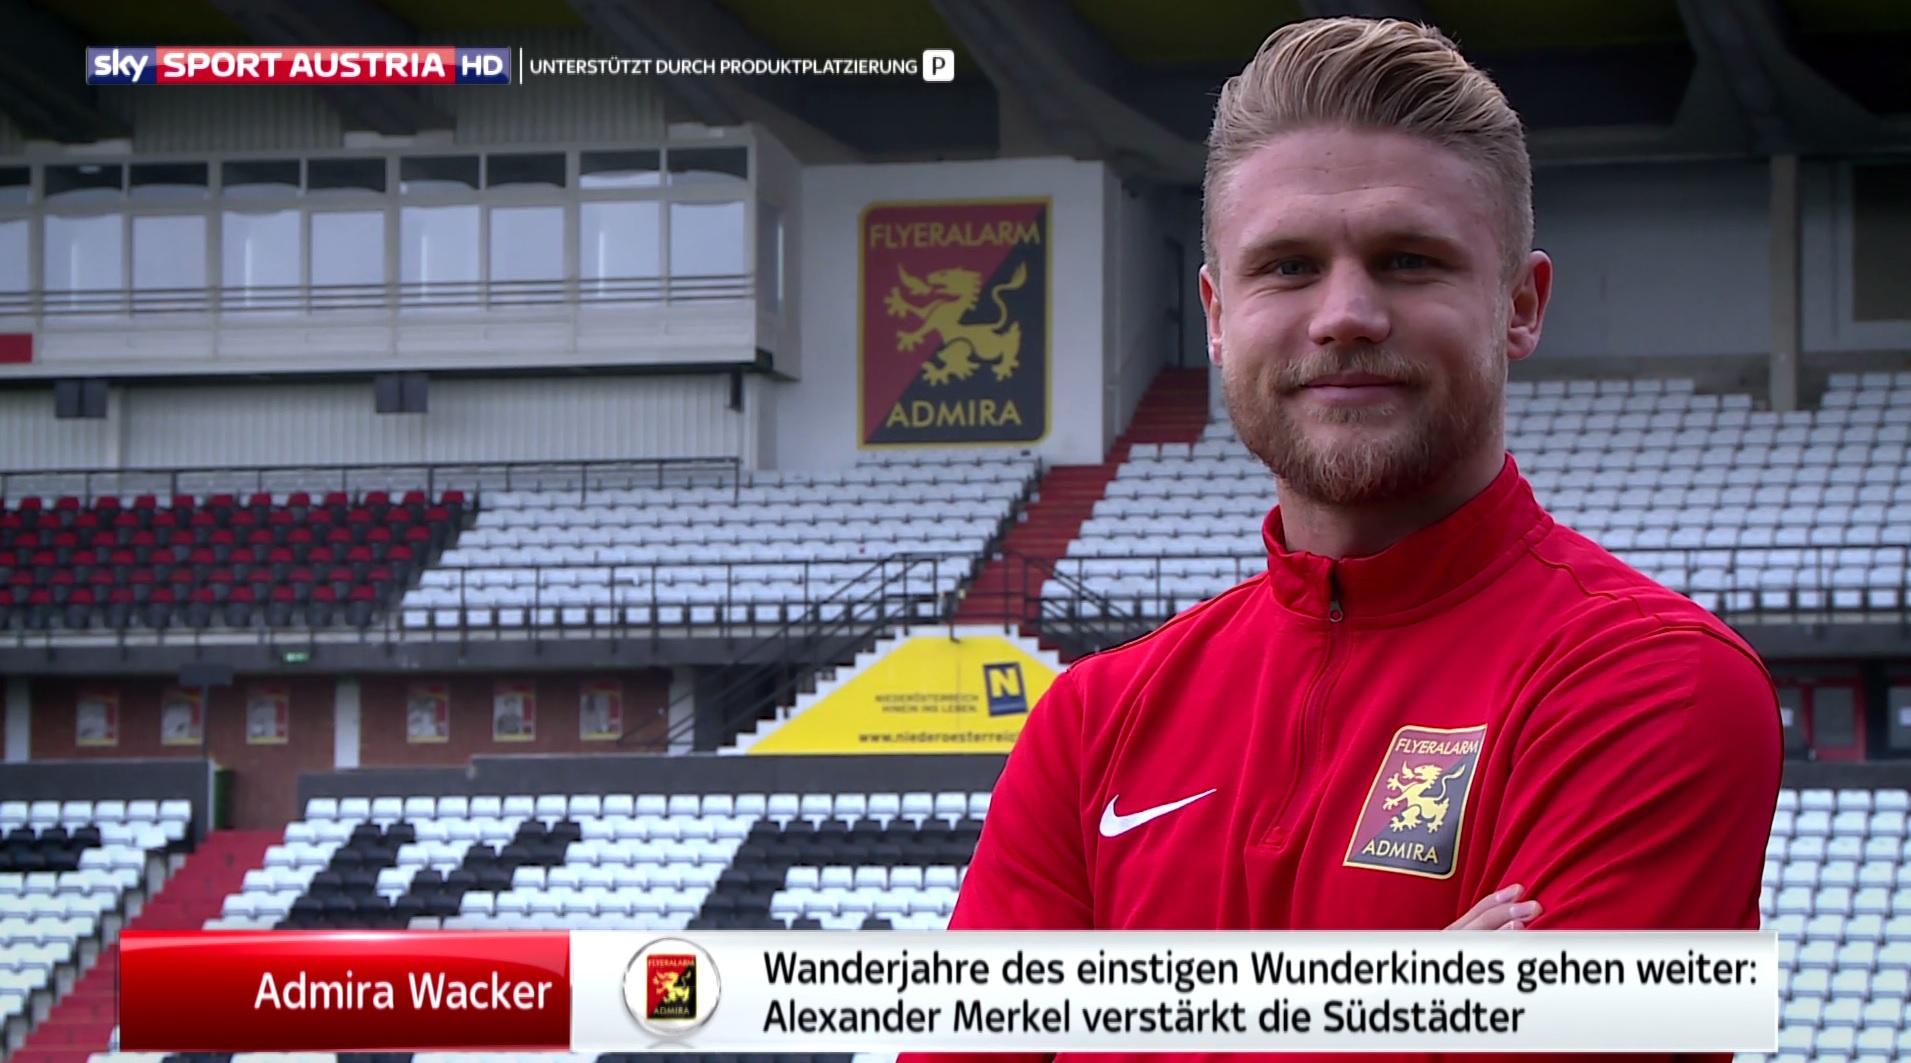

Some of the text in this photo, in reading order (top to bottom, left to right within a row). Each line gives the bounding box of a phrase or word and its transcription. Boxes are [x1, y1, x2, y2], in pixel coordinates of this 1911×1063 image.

[869, 221, 1041, 248] FLYERALARM
[886, 400, 1022, 428] ADMIRA
[1395, 738, 1479, 756] FLYERALARM
[1361, 838, 1439, 864] ADMIRA
